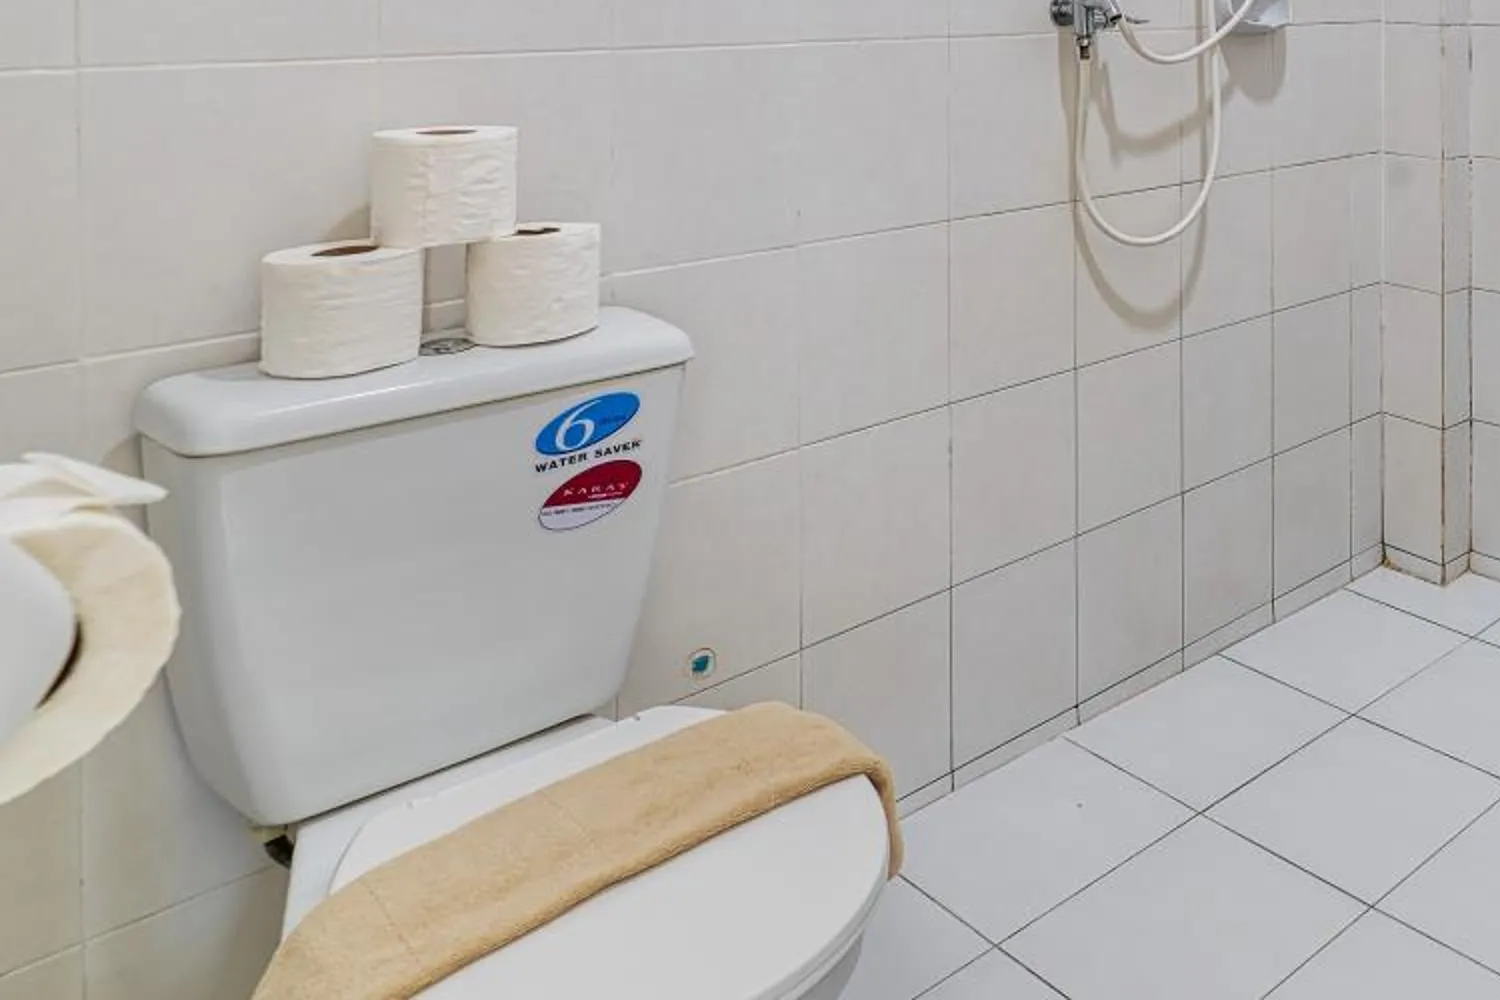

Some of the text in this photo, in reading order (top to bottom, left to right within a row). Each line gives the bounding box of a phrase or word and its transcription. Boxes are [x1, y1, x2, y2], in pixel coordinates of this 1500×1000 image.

[555, 399, 602, 451] 6
[535, 439, 642, 473] WATER SAVER
